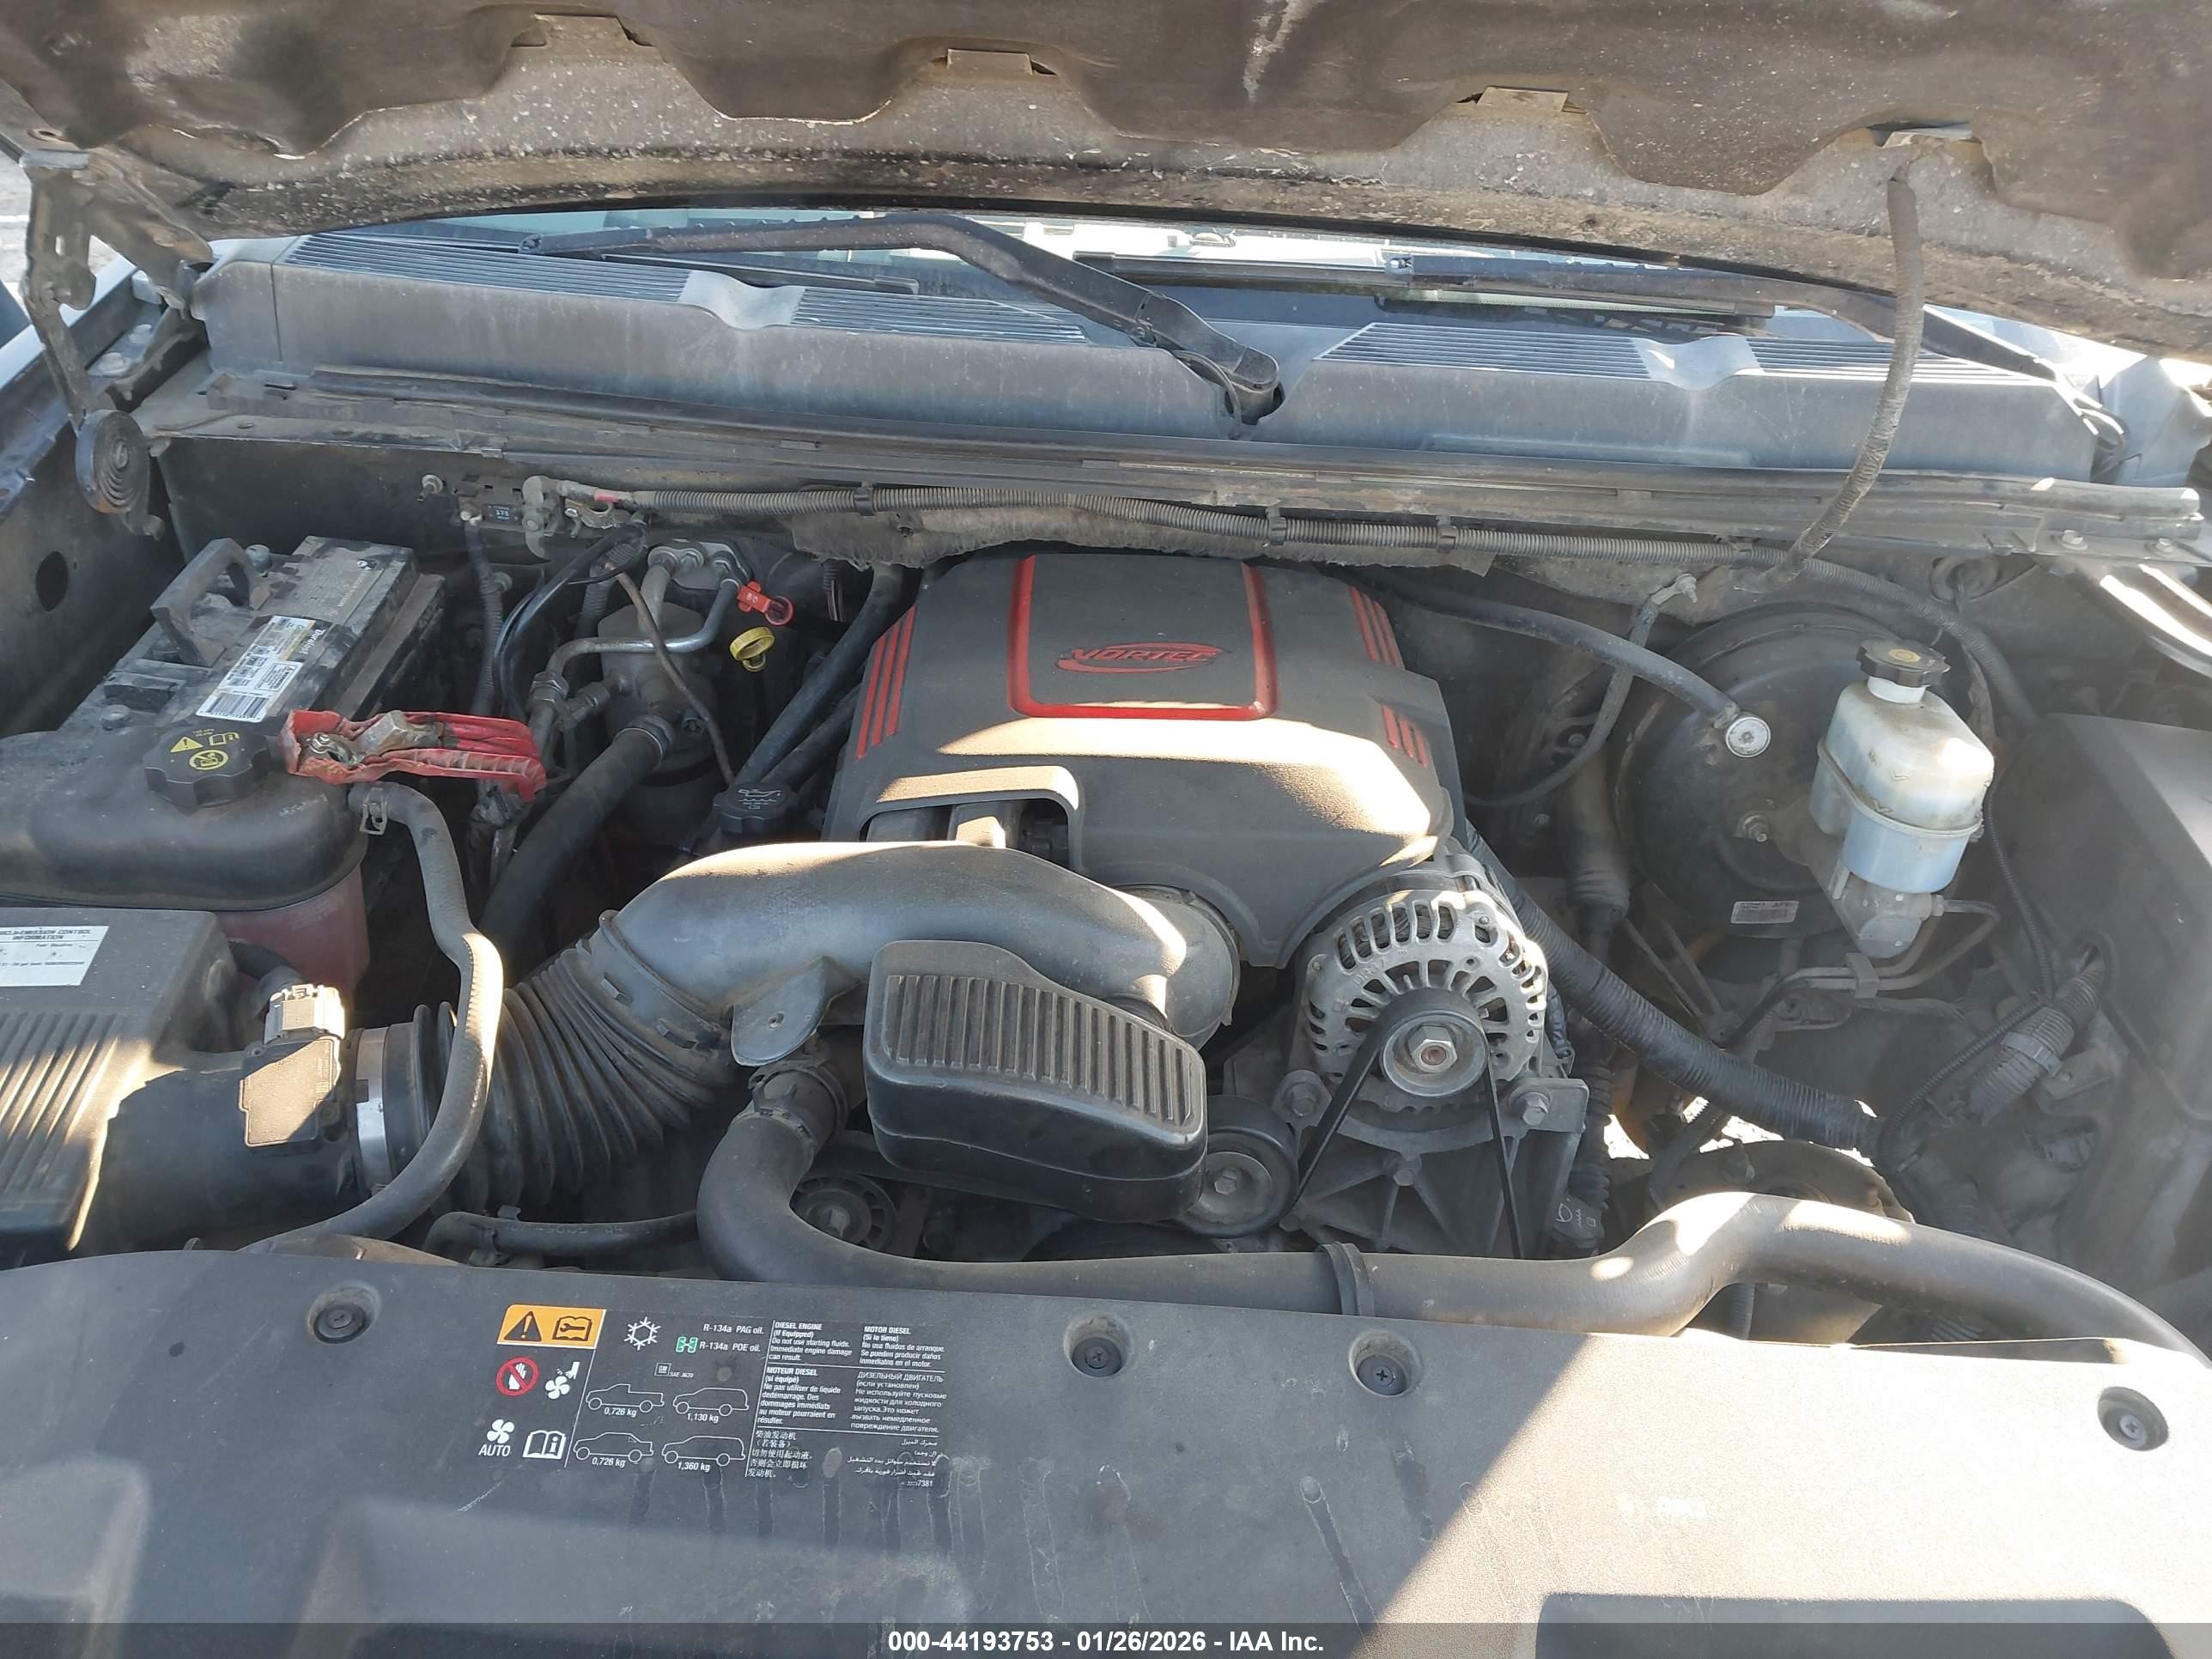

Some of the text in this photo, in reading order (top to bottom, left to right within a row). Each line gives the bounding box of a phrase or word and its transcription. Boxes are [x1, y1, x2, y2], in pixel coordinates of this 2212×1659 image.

[1072, 649, 1217, 661] VORTEC
[703, 1324, 732, 1333] R-134a
[782, 1330, 813, 1339] Equipped)
[699, 1341, 761, 1352] R-134a POE oil.
[857, 1371, 944, 1382] ДИЗЕЛЬНЫЙ ДВИГАТЕЛЬ
[877, 1382, 920, 1390] установлен)
[604, 1407, 637, 1419] 0,726 kg
[687, 1413, 719, 1424] 1,130 kg
[851, 1422, 900, 1431] повреждение
[756, 1430, 797, 1440] 柴油发动机
[478, 1444, 511, 1457] AUTO
[592, 1457, 625, 1468] 0,726 kg
[678, 1462, 710, 1473] 1,360 kg
[750, 1459, 807, 1469] 否则会立即损坏
